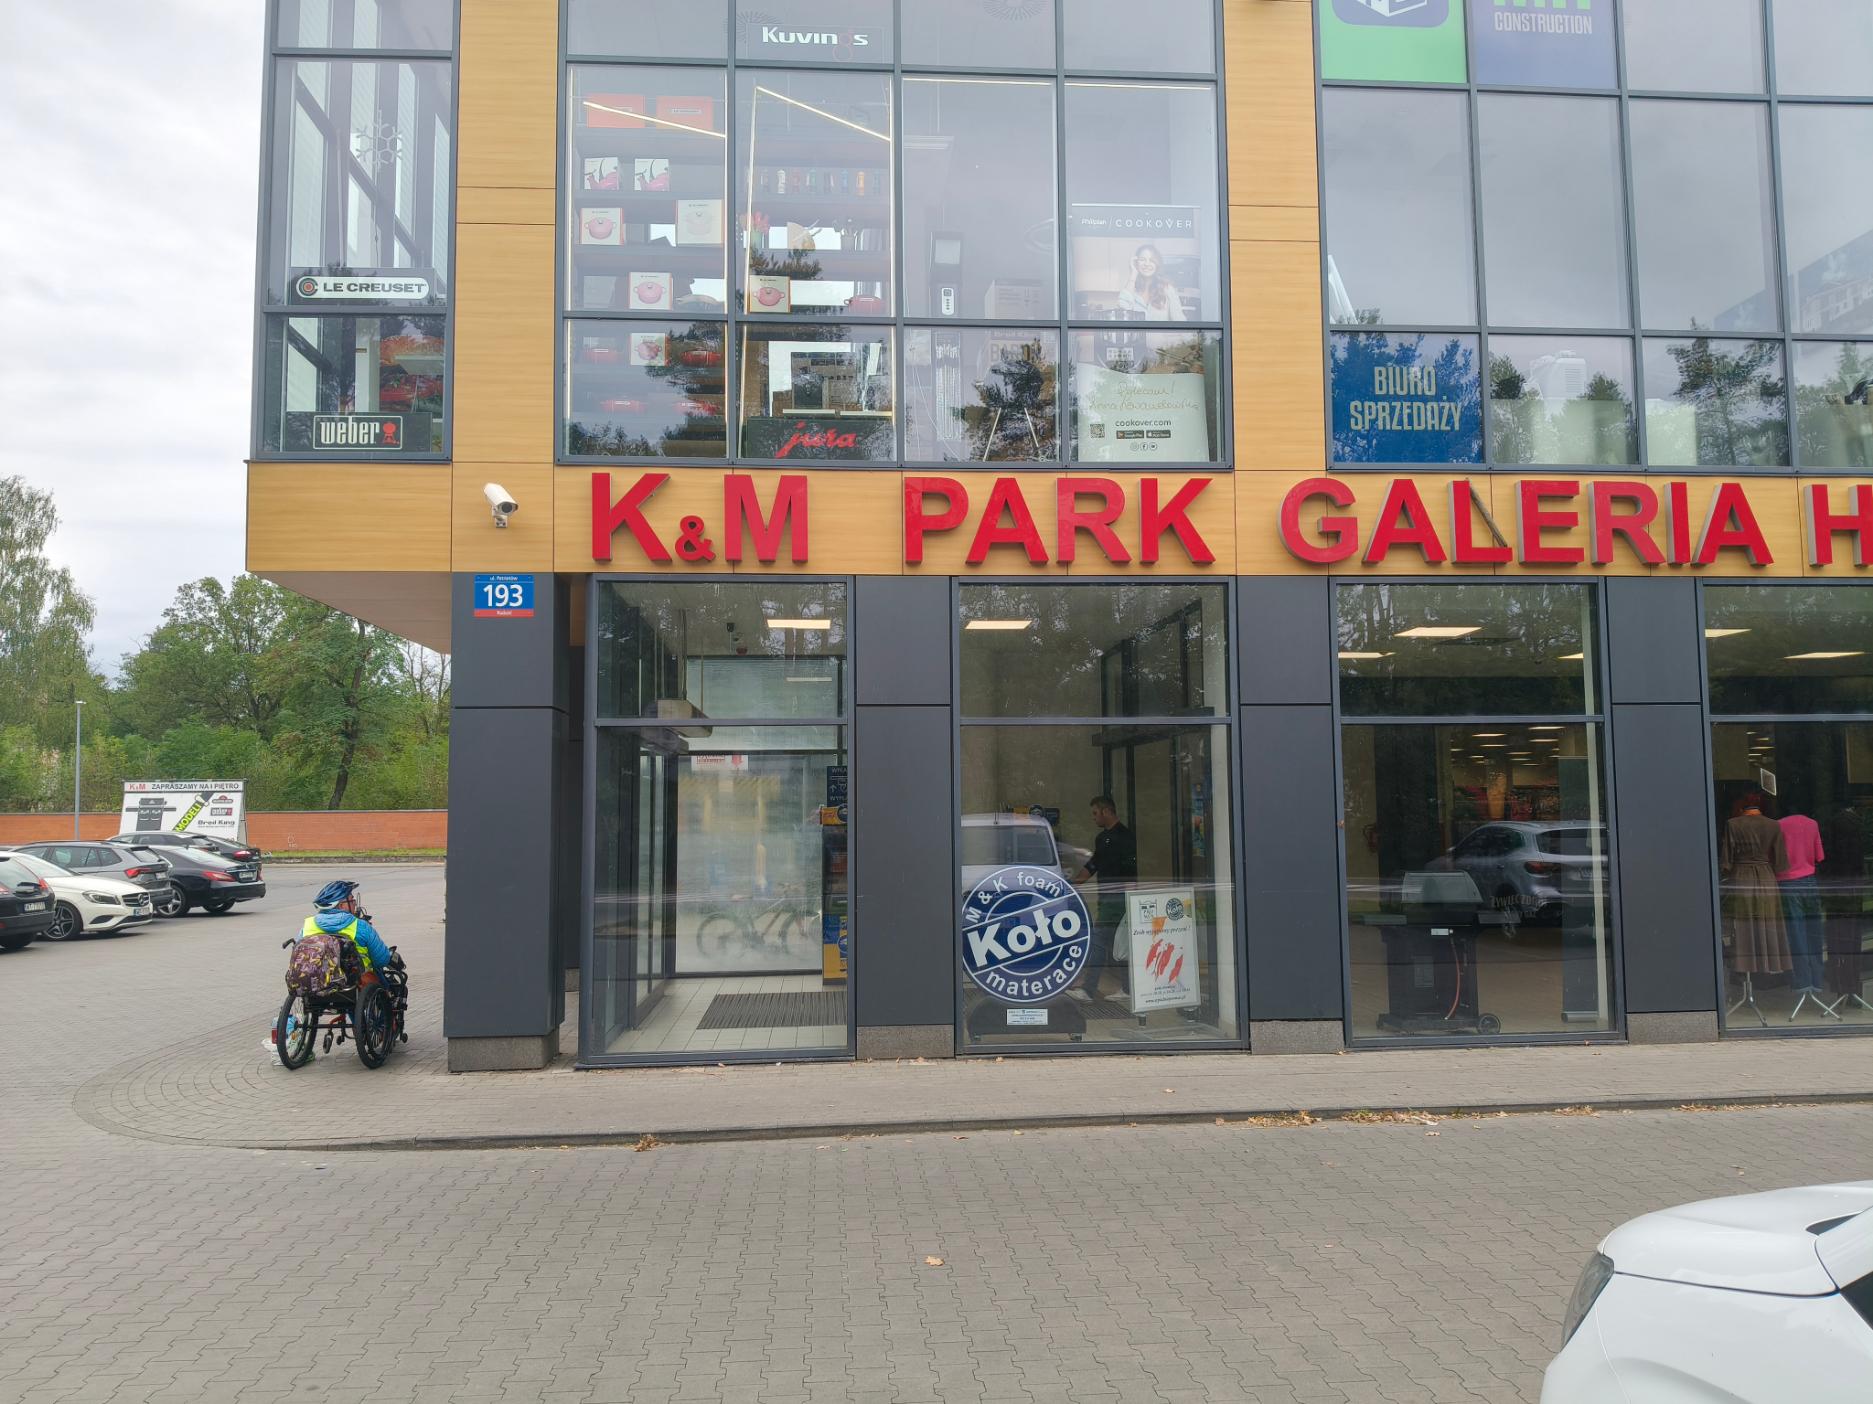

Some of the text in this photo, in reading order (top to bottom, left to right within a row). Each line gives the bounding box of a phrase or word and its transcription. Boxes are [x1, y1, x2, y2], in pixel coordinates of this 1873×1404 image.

[1494, 12, 1592, 34] CONSTRUCTION
[1115, 219, 1192, 229] COOKOVER
[323, 282, 426, 293] LE CREUSET
[1374, 366, 1436, 395] BIURO
[1115, 419, 1172, 427] cookover.com
[1350, 395, 1461, 431] SPRZEDAŻY
[320, 416, 380, 445] weber
[775, 421, 857, 458] jura
[592, 472, 1873, 567] K&M PARK GALERIA H
[483, 584, 523, 607] 193
[214, 783, 240, 791] PIĘTRO
[965, 872, 1062, 923] M & K foam
[967, 909, 1081, 968] Koło
[986, 945, 1082, 996] materace
